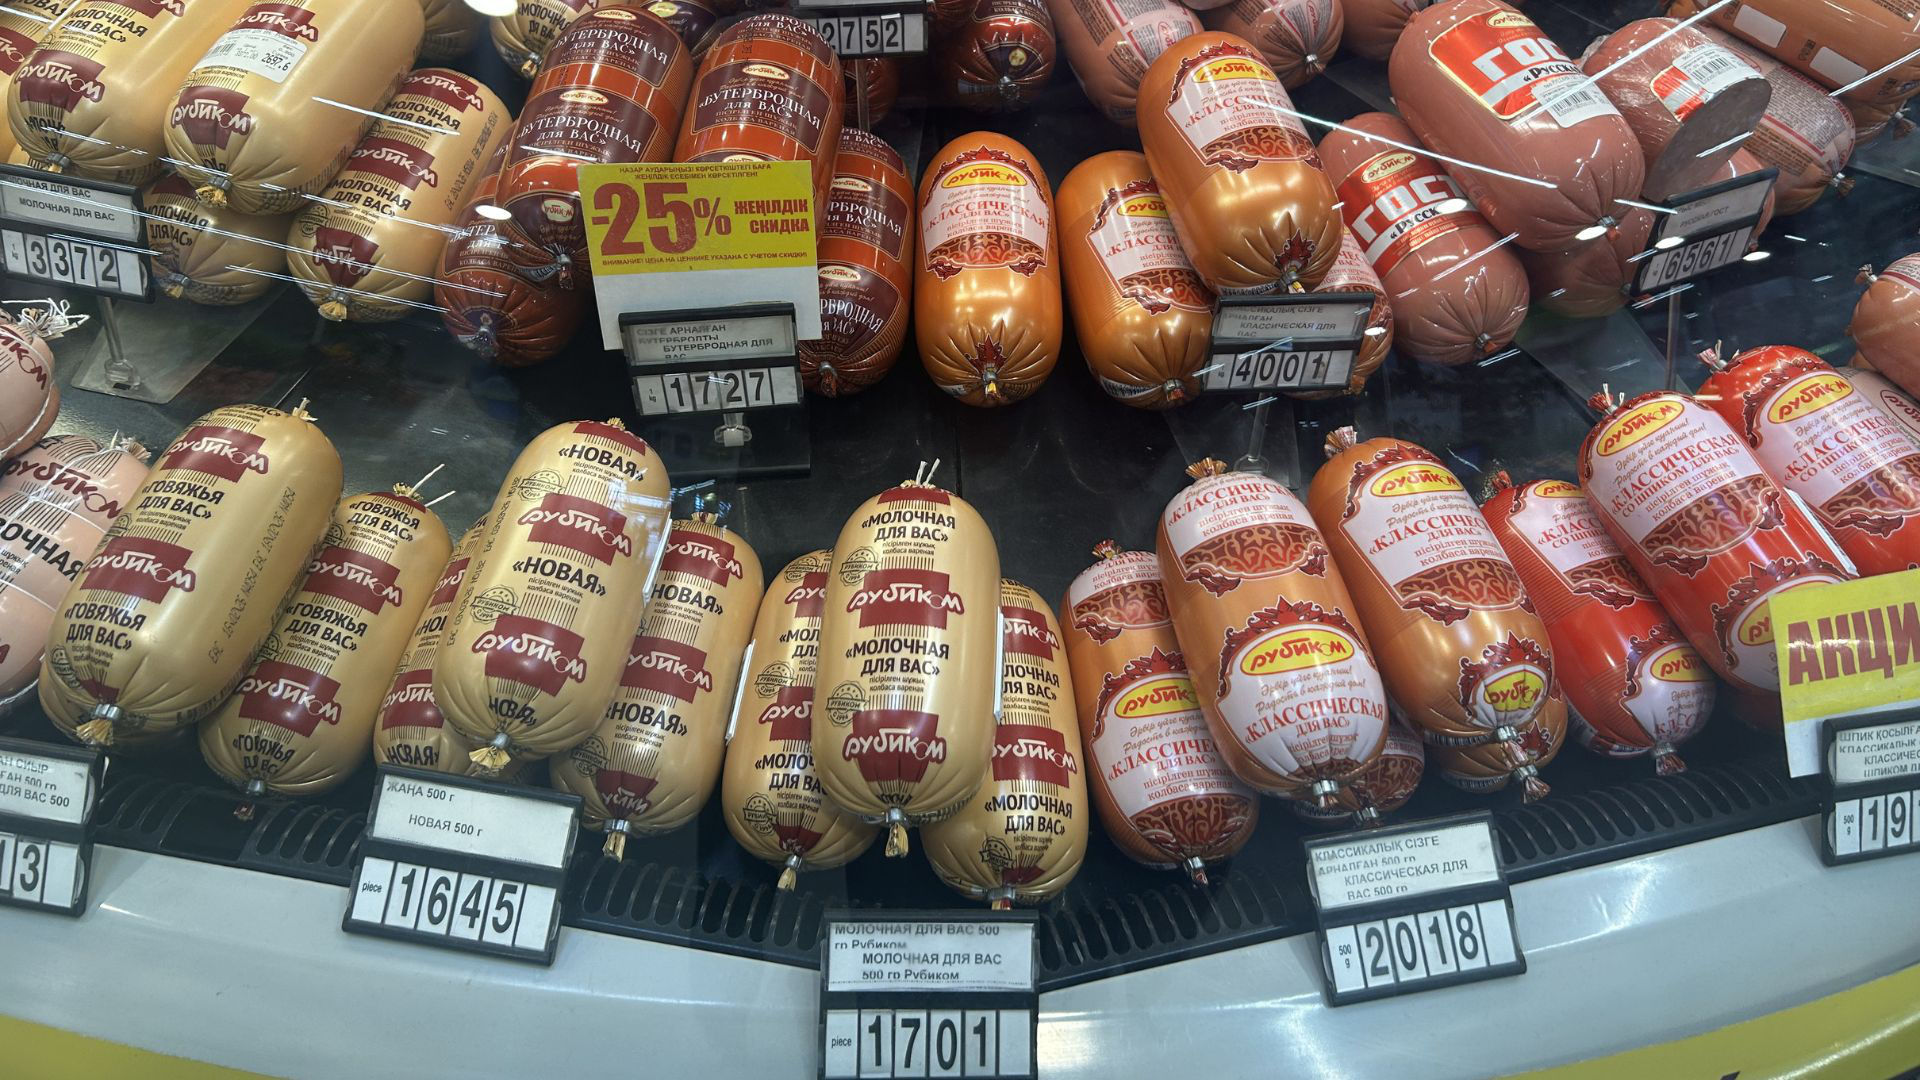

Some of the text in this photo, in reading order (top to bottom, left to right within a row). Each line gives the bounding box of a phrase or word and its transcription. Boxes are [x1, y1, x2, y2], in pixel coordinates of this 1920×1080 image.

[822, 19, 899, 49] 2752
[571, 130, 607, 146] ВАС»
[19, 197, 115, 222] МОЛОЧНАЯ ДЛЯ ВАС
[332, 190, 361, 208] ДЛЯ
[734, 199, 808, 217] ЖЕҢІЛДІК
[592, 182, 731, 256] -25%
[749, 218, 810, 234] СКИДКА
[31, 240, 118, 283] 3372
[645, 257, 664, 265] ЦЕНА
[750, 252, 778, 260] УЧЕТОМ
[1664, 233, 1734, 280] 6561
[1240, 322, 1336, 331] КЛАССИЧЕСКАЯ ДЛЯ
[663, 338, 773, 353] БУТЕРБРОДНАЯ ДЛЯ
[1235, 352, 1325, 384] 4001
[670, 371, 765, 406] 1727
[558, 444, 645, 482] «НОВАЯ»
[1800, 433, 1873, 483] СО ШПИКОМ
[1611, 433, 1740, 516] «КЛАССИЧЕСКАЯ
[142, 480, 225, 505] «ГОВЯЖЬЯ
[1622, 465, 1690, 518] СО ШПИКОМ
[1652, 470, 1737, 522] колбаса вареная
[137, 496, 212, 519] ДЛЯ ВАС»
[349, 500, 421, 530] «ГОВЯЖЬЯ
[347, 511, 414, 543] ДЛЯ ВАС»
[861, 510, 956, 530] «МОЛОЧНАЯ
[1202, 512, 1294, 538] колбаса вареная
[874, 525, 948, 543] ДЛЯ ВАС»
[1427, 527, 1452, 543] ДЛЯ
[1552, 537, 1570, 549] СО
[1420, 550, 1466, 567] колбаса
[512, 557, 607, 597] «НОВАЯ»
[64, 602, 147, 632] «ГОВЯЖЬЯ
[286, 602, 368, 637] «ГОВЯЖЬЯ
[65, 624, 133, 651] ДЛЯ ВАС»
[284, 619, 358, 652] ДЛЯ ВАС»
[845, 637, 950, 661] «МОЛОЧНАЯ
[860, 657, 940, 677] ДЛЯ ВАС»
[869, 683, 924, 693] колбаса вареная
[1027, 683, 1057, 700] ВАС»
[1245, 697, 1384, 746] «КЛАССИЧЕСКАЯ
[1296, 714, 1350, 738] ДЛЯ ВАС»
[1840, 730, 1874, 742] ШПИК
[1156, 756, 1183, 772] ДЛЯ
[387, 781, 455, 802] ЖАҢА 500 г
[769, 773, 799, 791] ДЛЯ
[1148, 784, 1190, 801] колбаса
[25, 789, 47, 803] ВАС
[49, 795, 70, 808] 500
[984, 794, 1073, 819] «МОЛОЧНАЯ
[409, 814, 483, 837] НОВАЯ 500 г
[1005, 815, 1066, 836] ДЛЯ ВАС»
[1843, 815, 1854, 824] 500
[1846, 828, 1851, 836] g
[1315, 836, 1440, 862] КЛАССИКАЛЫҚ СІЗГЕ
[1344, 859, 1468, 886] КЛАССИЧЕСКАЯ ДЛЯ
[362, 881, 382, 894] piece
[1347, 888, 1371, 900] ВАС
[1374, 885, 1392, 895] 500
[401, 868, 518, 934] 1645
[835, 924, 1000, 936] МОЛОЧНАЯ ДЛЯ ВАС 500
[1339, 944, 1351, 955] 500
[1365, 910, 1479, 977] 2018
[862, 953, 1002, 966] МОЛОЧНАЯ ДЛЯ ВАС
[1345, 959, 1350, 968] g
[862, 969, 883, 980] 500
[904, 969, 959, 980] Рубиком
[831, 1035, 852, 1048] piece
[868, 1015, 988, 1071] 1701
